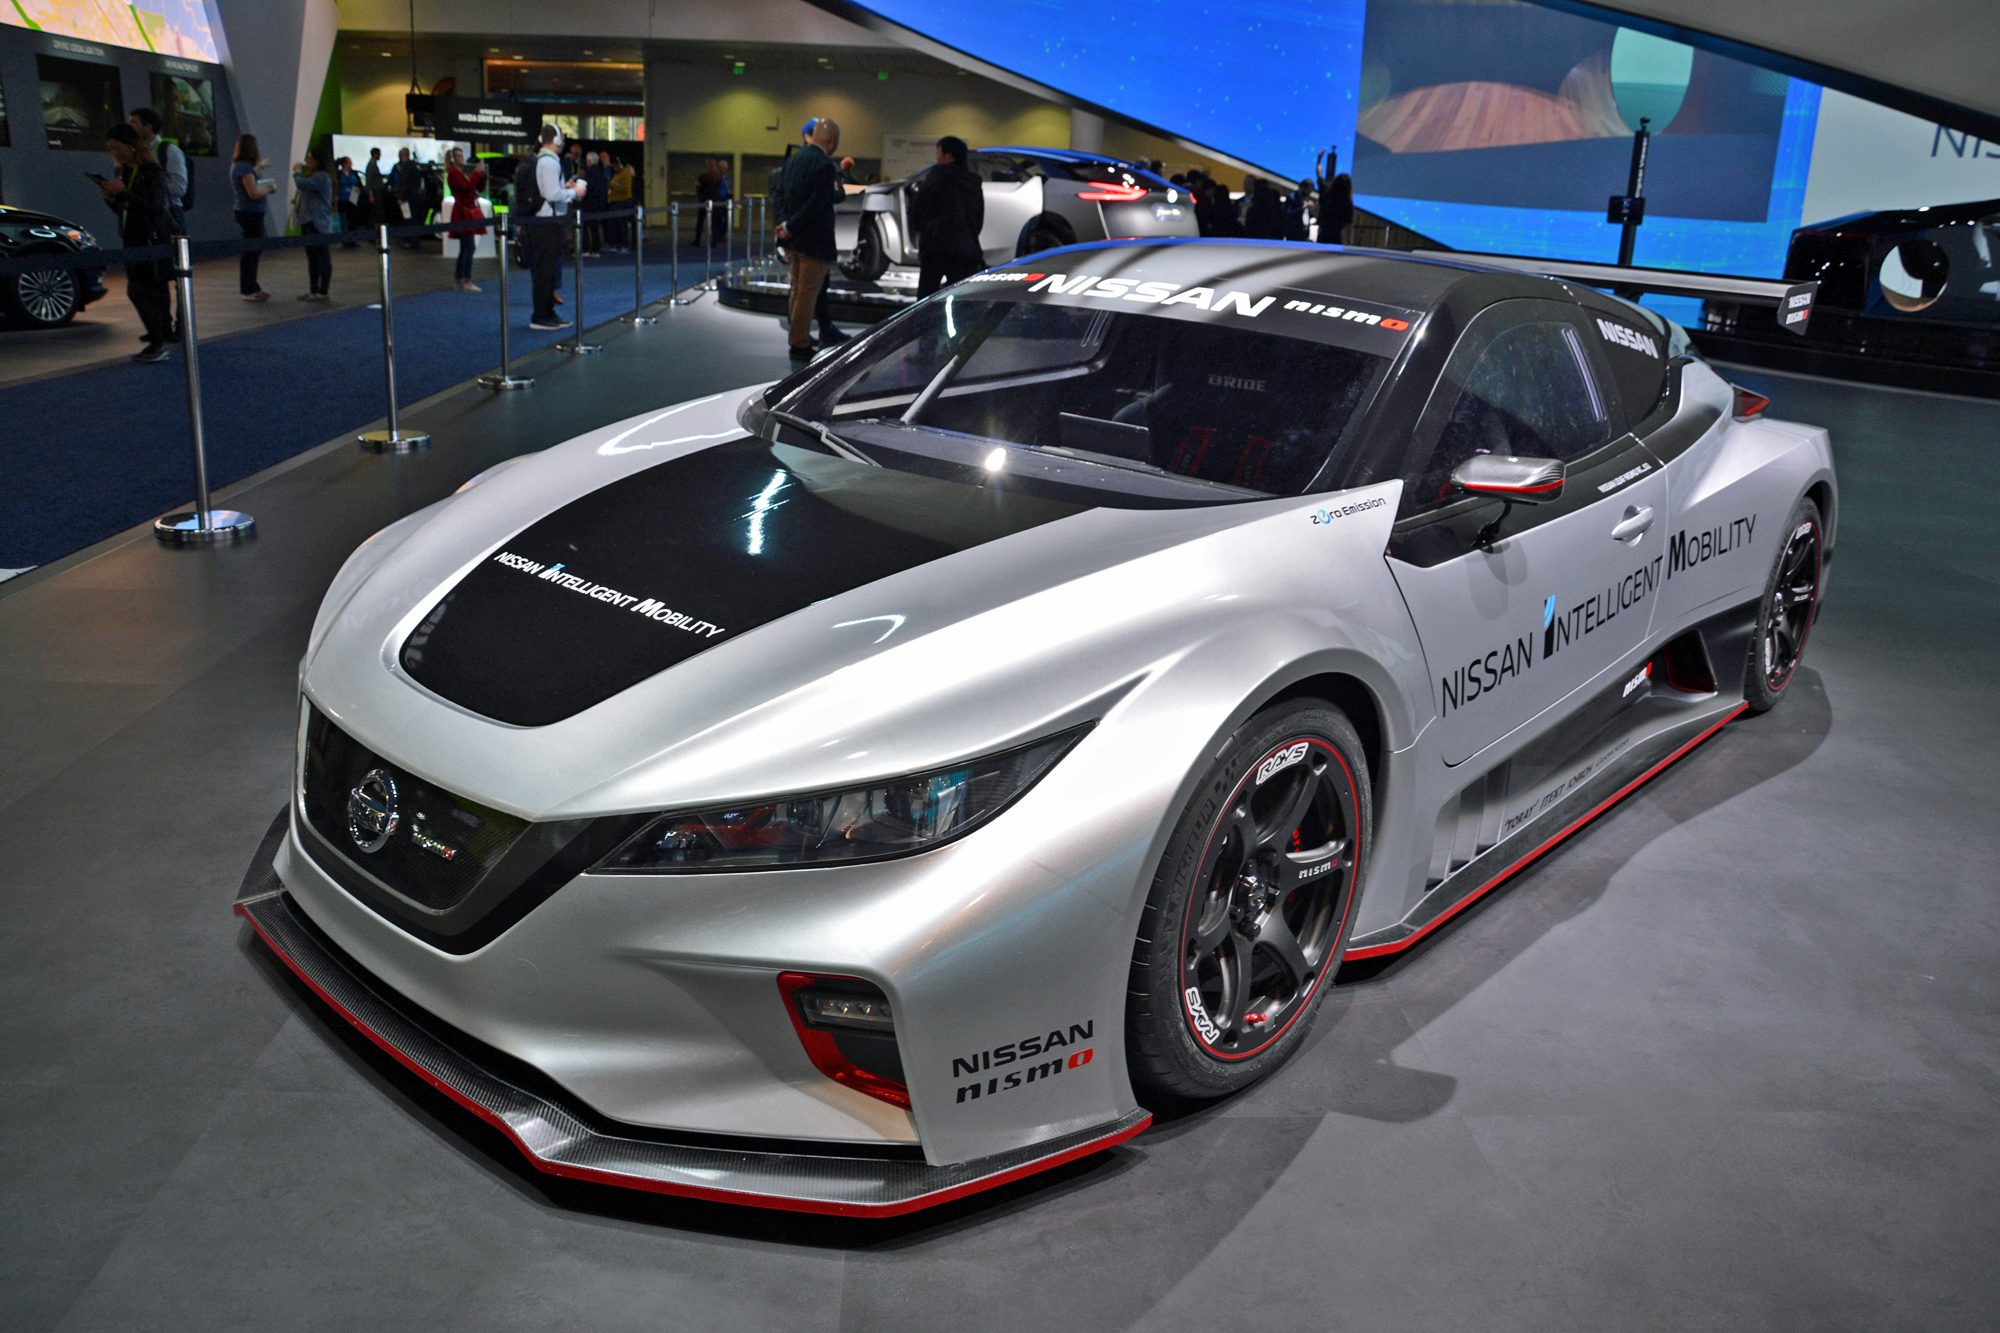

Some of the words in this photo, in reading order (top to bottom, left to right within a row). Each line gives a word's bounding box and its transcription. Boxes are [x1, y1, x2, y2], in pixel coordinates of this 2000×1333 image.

[1930, 124, 2000, 159] NI
[1028, 274, 1277, 317] NISSAN
[1283, 300, 1409, 331] nismo
[1788, 293, 1812, 309] NISSAN
[1596, 318, 1659, 359] NISSAN
[1208, 374, 1267, 392] BRIDE
[1341, 497, 1387, 516] Emission
[493, 551, 545, 575] NISSAN
[538, 563, 639, 608] INTELLIGENT
[630, 598, 726, 638] MOBILITY
[1442, 632, 1533, 718] NISSAN
[1543, 594, 1664, 660] INTELLIGENT
[1667, 513, 1757, 581] MOBILITY
[1257, 743, 1308, 783] RAYS
[1186, 988, 1220, 1043] RAYS
[952, 1019, 1094, 1078] NISSAN
[956, 1048, 1094, 1104] nismo
